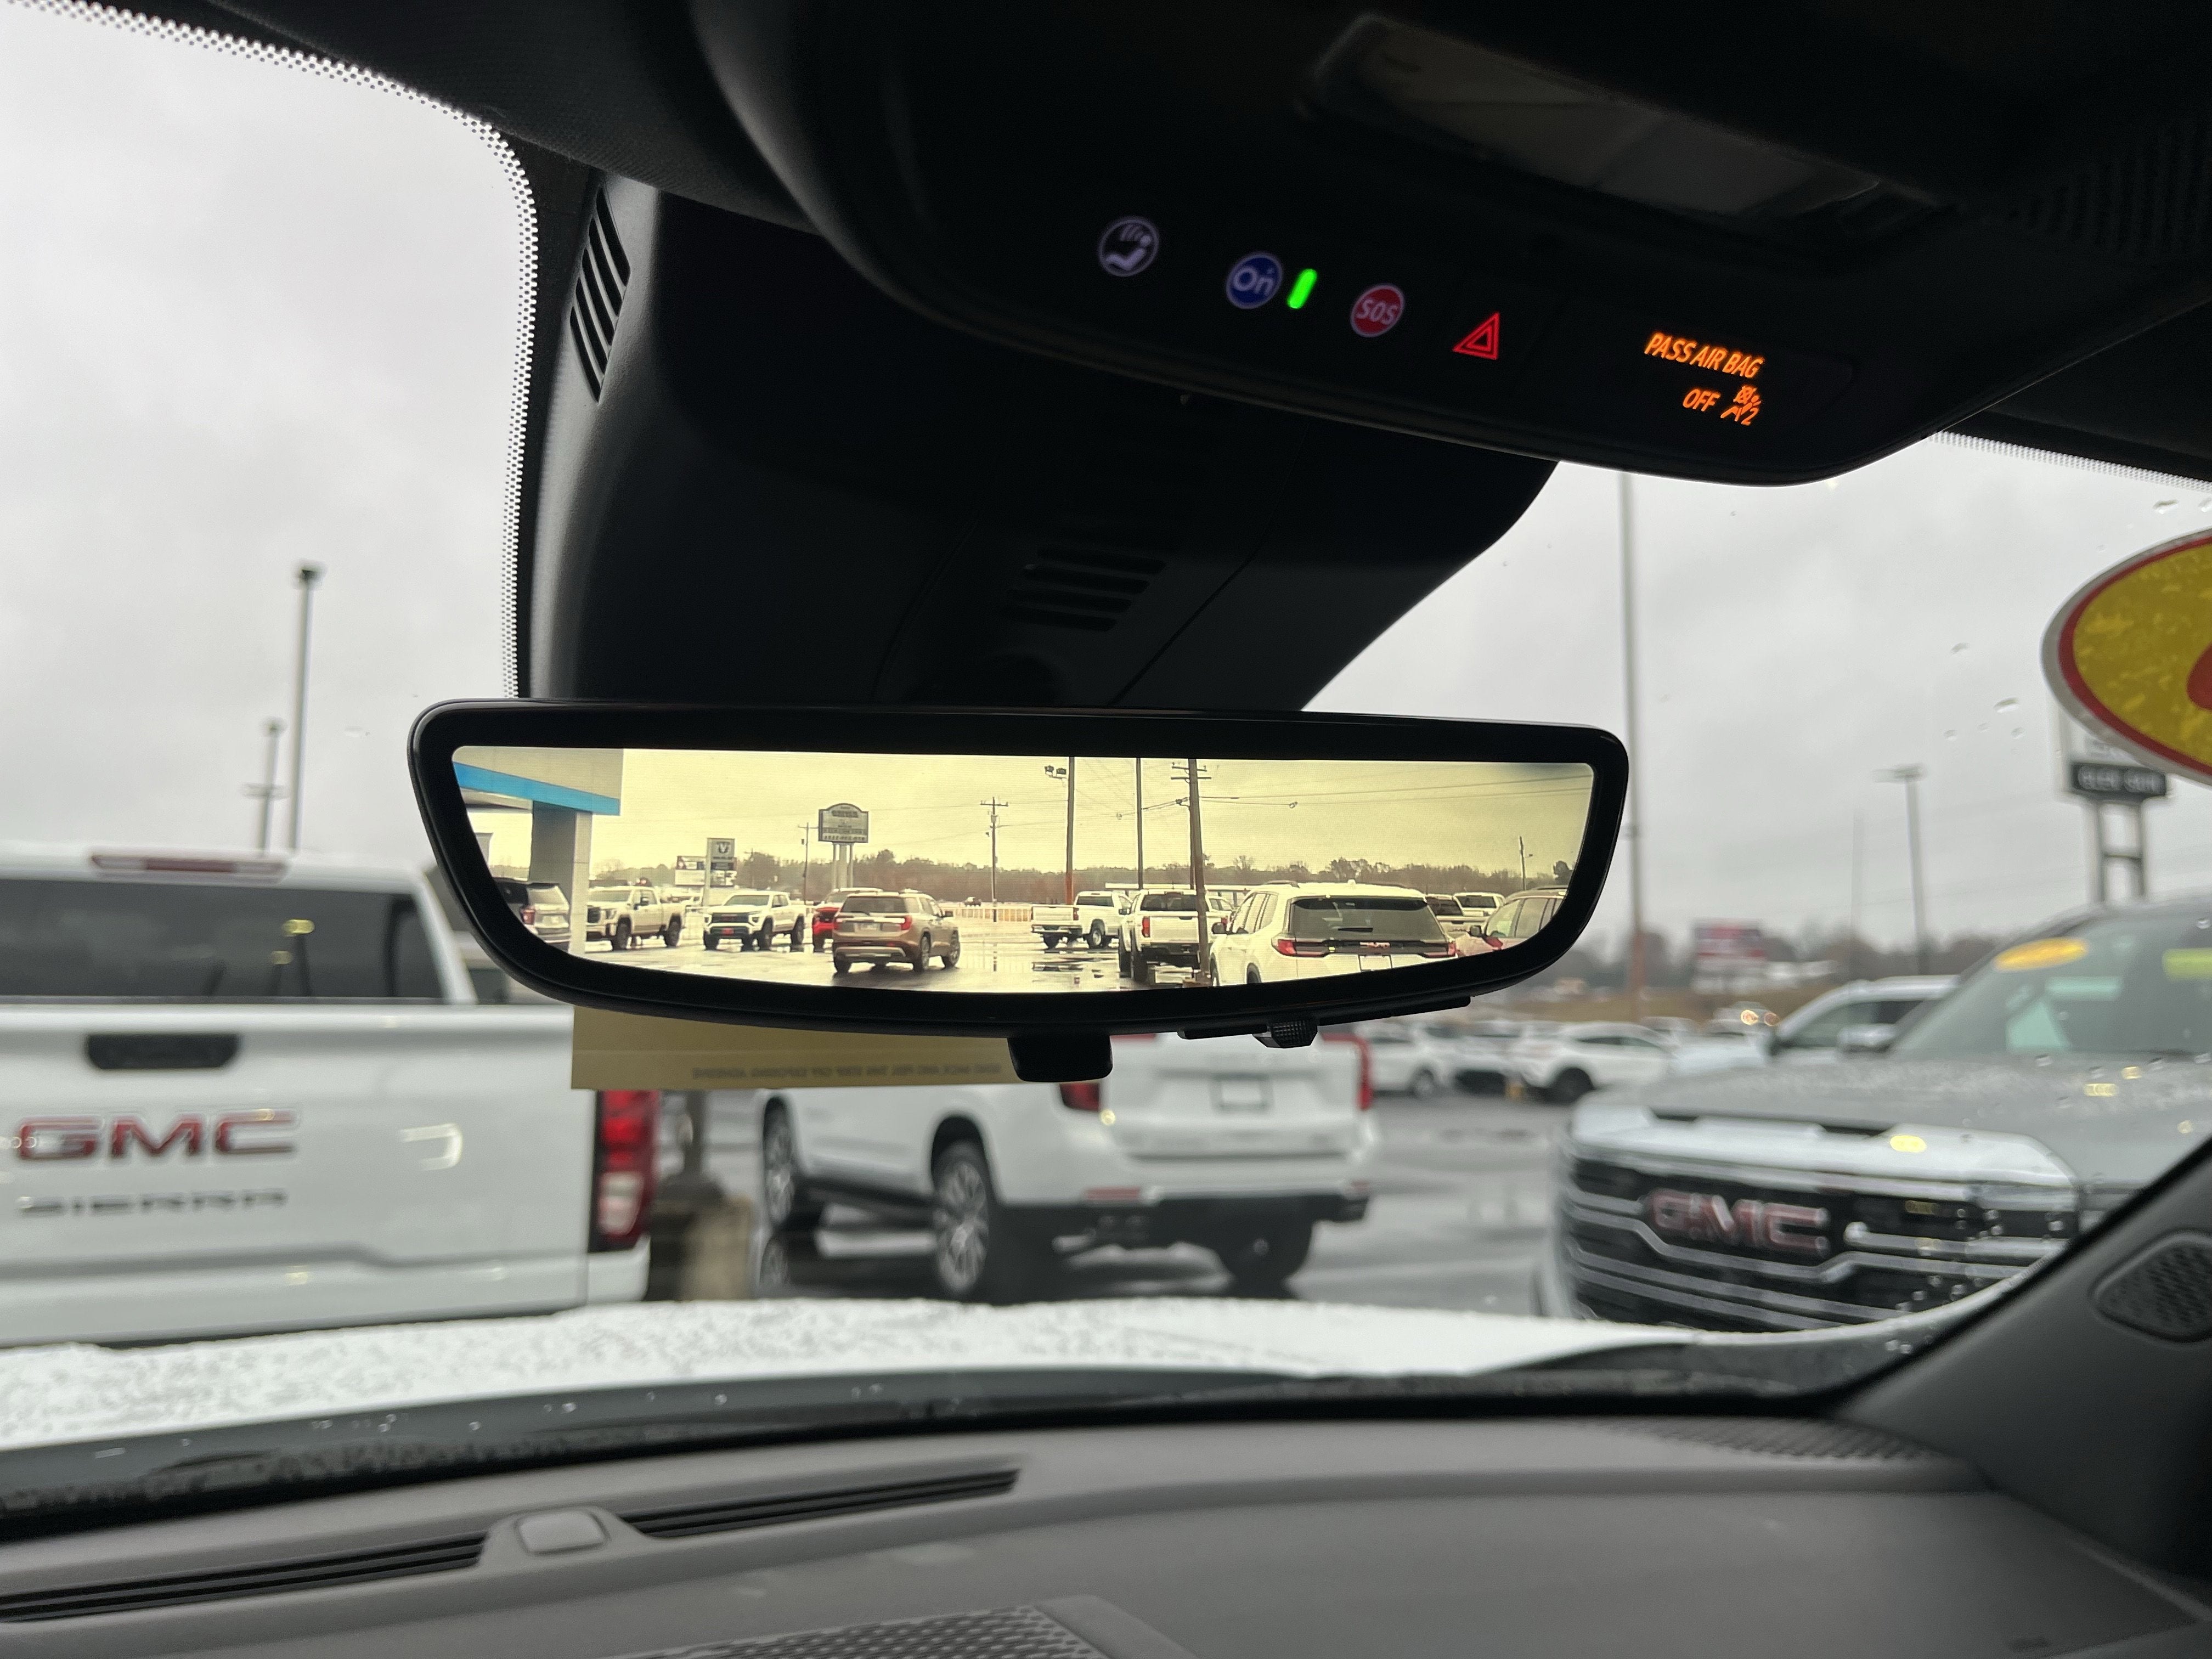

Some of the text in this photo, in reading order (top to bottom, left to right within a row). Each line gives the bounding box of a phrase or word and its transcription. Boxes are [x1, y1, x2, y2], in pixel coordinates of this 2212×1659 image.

[1233, 266, 1274, 295] On
[1357, 299, 1401, 325] SOS
[1644, 331, 1764, 378] PASS AIR BAG
[1682, 387, 1722, 412] OFF
[18, 1108, 296, 1160] GMC
[1648, 1189, 1830, 1254] GMC
